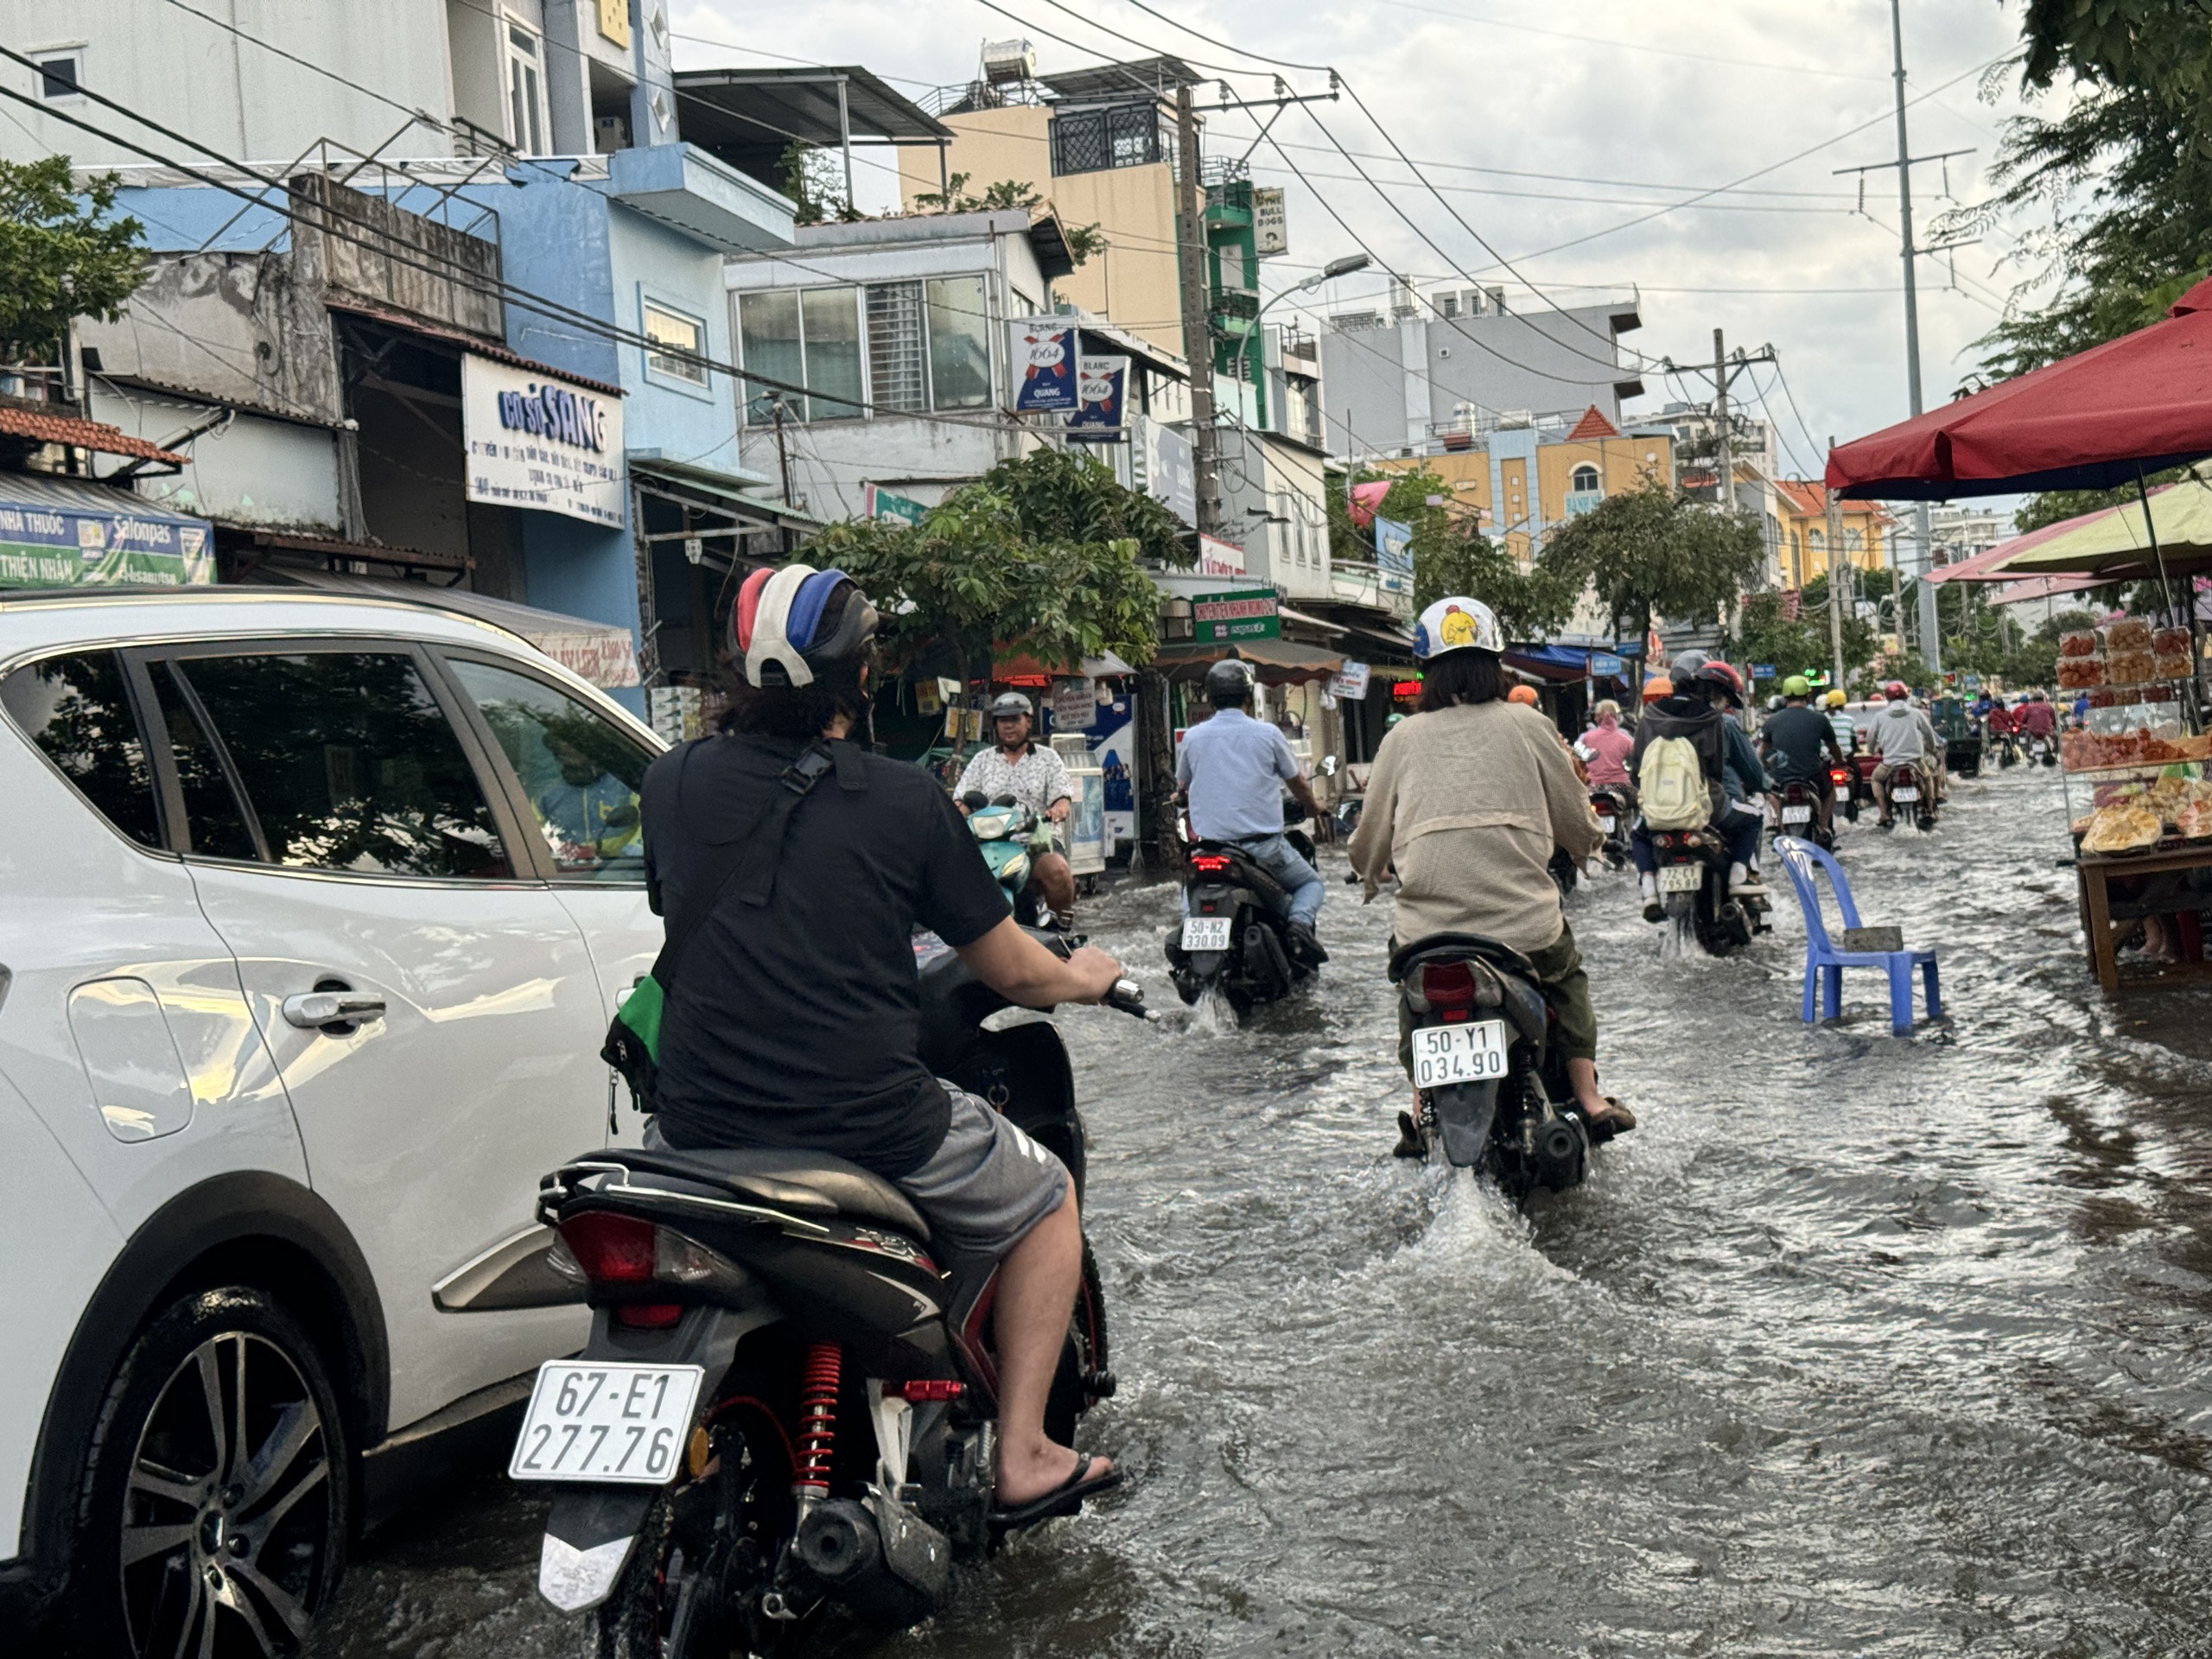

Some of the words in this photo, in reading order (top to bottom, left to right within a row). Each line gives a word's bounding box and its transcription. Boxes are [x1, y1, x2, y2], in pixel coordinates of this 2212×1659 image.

[1258, 215, 1283, 227] DOGS
[1260, 207, 1283, 217] BULL
[1029, 348, 1059, 360] 1664
[1084, 361, 1110, 370] BLANC
[1081, 384, 1109, 395] 1664
[541, 385, 608, 454] SANG
[24, 508, 65, 536] THUỐC
[113, 515, 172, 547] Salonpas
[1, 550, 39, 583] THIỆN
[40, 553, 74, 583] NHÂN
[1185, 934, 1226, 948] 330.09
[1191, 920, 1224, 934] 50-N2
[1427, 1027, 1487, 1055] 50-Y1
[1421, 1051, 1501, 1083] 034.90
[555, 1371, 671, 1420] 67-E1
[522, 1423, 674, 1474] 277.76
